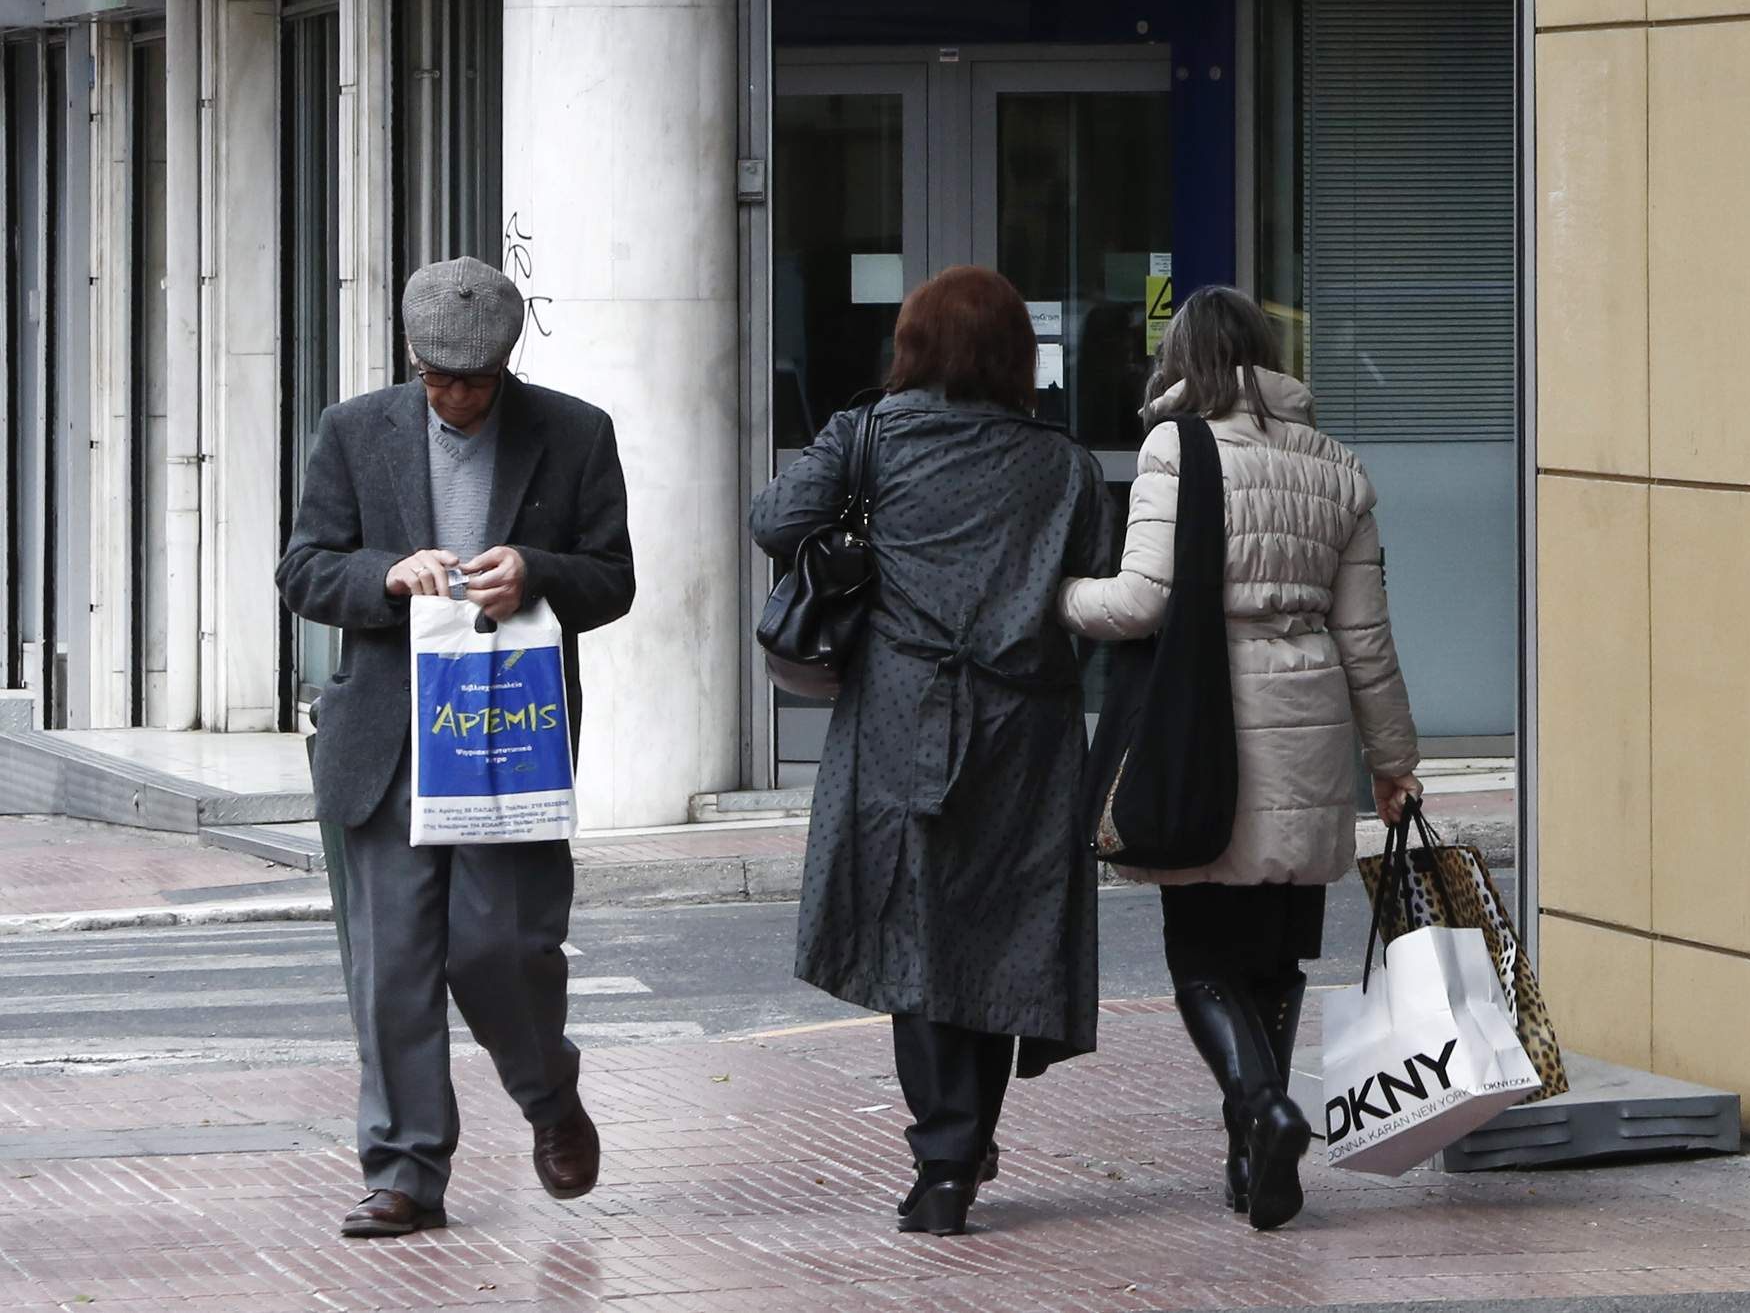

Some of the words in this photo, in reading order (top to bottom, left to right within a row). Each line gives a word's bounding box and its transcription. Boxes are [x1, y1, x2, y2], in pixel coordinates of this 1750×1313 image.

[1326, 1038, 1458, 1145] DKNY
[1328, 1136, 1367, 1162] DONNA
[1367, 1115, 1411, 1141] KARAN
[1412, 1101, 1438, 1120] NEW
[1438, 1086, 1470, 1108] YORK
